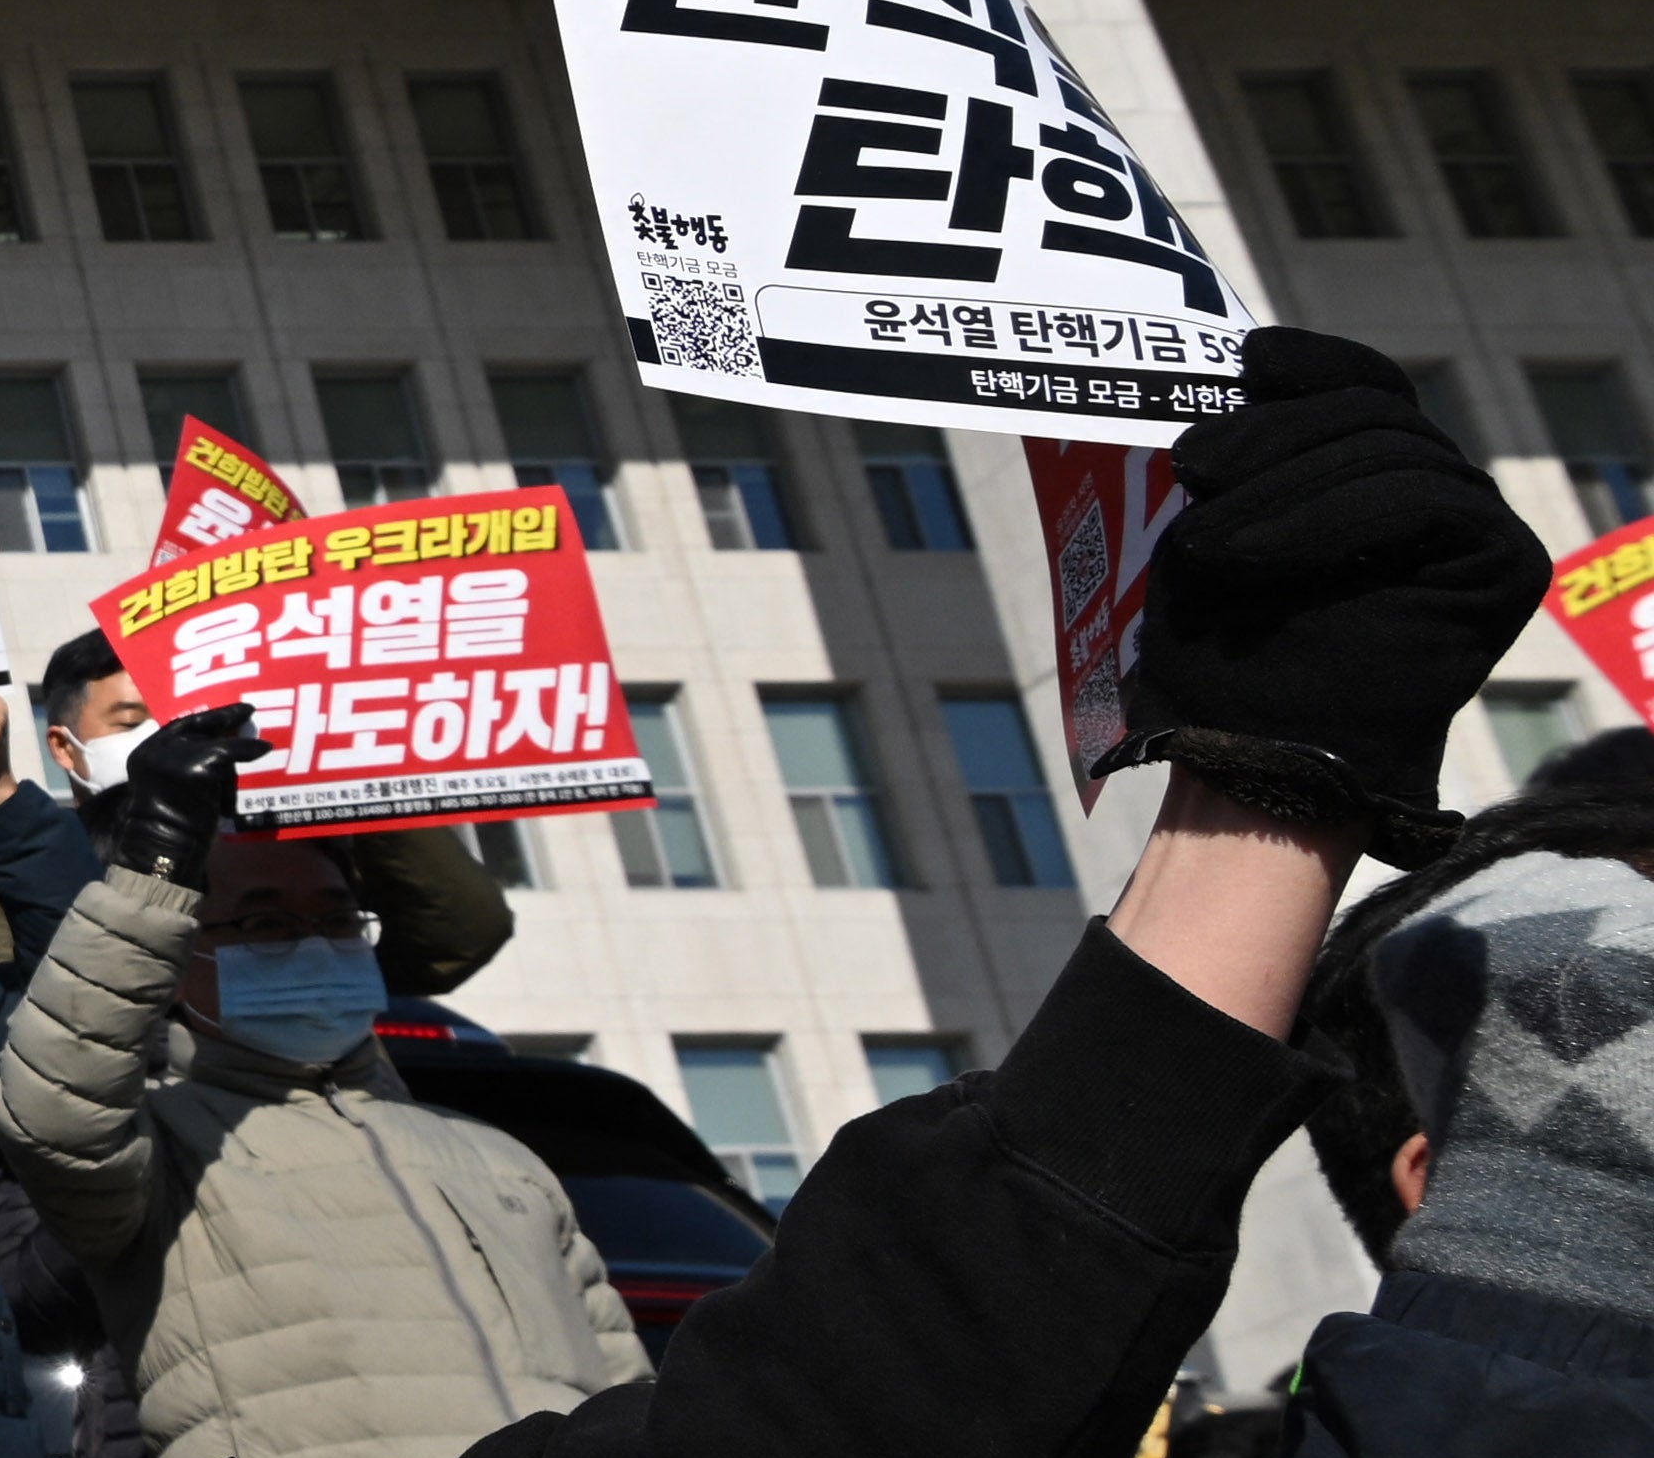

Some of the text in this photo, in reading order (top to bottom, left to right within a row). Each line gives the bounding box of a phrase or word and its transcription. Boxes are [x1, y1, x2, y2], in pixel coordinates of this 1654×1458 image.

[628, 199, 729, 254] 촛불행동
[785, 77, 1229, 318] 탄핵
[706, 260, 738, 279] 모금
[864, 299, 998, 351] 윤석열
[1010, 310, 1188, 364] 탄핵기금
[971, 369, 1079, 404] 탄핵기금
[1088, 379, 1142, 408] 모금
[185, 436, 289, 519] 건희방탄
[119, 504, 558, 638] 건희방탄 우크라개입
[170, 568, 530, 698] 윤석열을
[236, 662, 610, 776] 타도하자!
[363, 777, 438, 799] 촛불대행진
